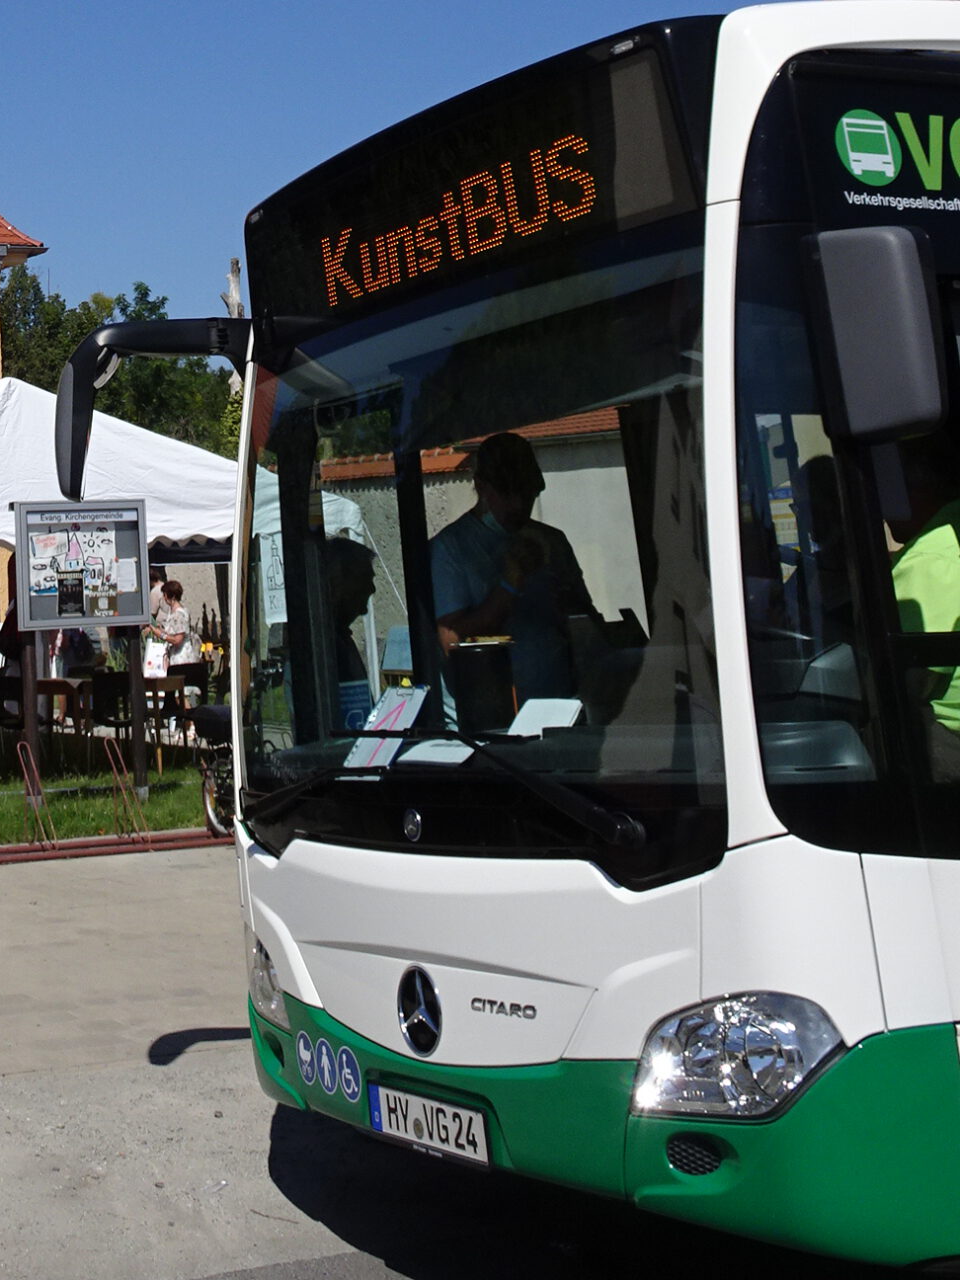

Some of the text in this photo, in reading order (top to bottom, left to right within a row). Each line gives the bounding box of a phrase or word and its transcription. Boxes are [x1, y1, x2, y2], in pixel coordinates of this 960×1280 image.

[321, 134, 597, 307] KunstBUS
[65, 511, 123, 522] Kirchengemeinde
[471, 997, 537, 1019] CITARO
[386, 1093, 409, 1133] HY
